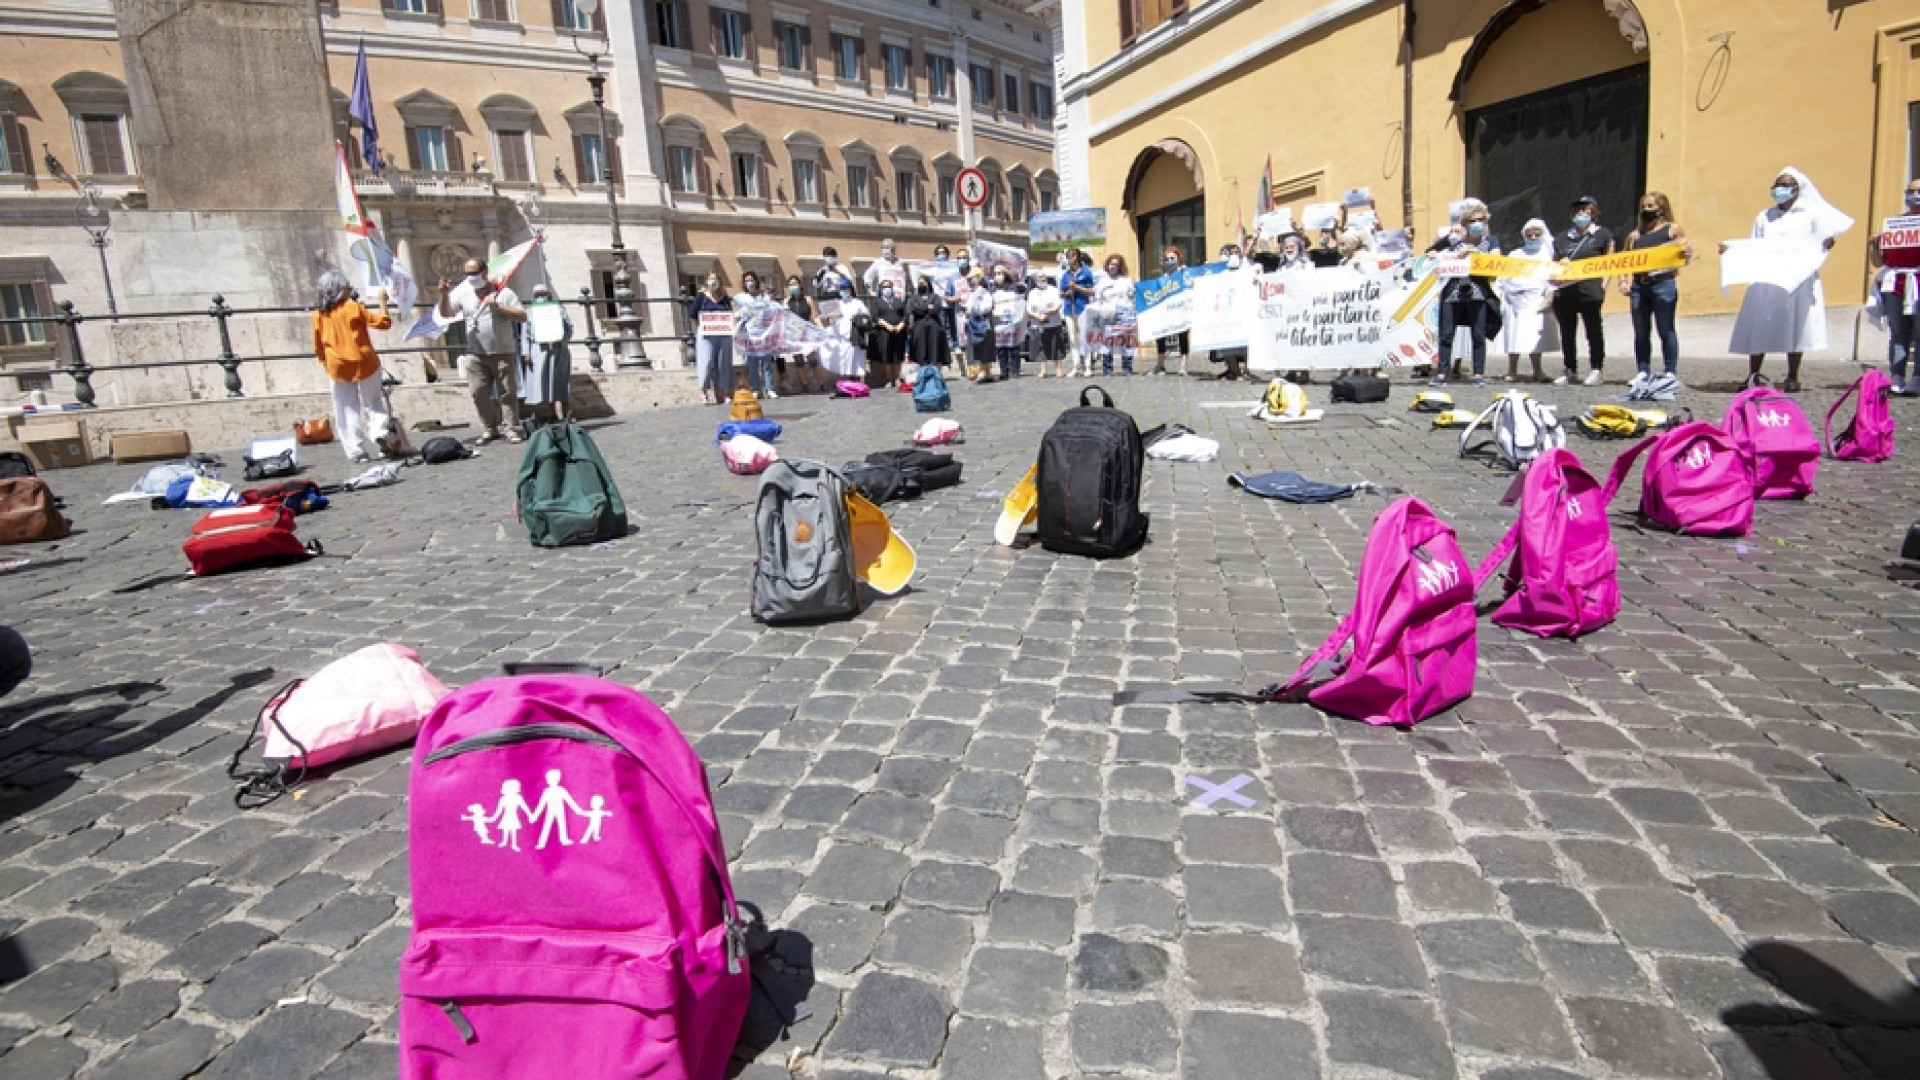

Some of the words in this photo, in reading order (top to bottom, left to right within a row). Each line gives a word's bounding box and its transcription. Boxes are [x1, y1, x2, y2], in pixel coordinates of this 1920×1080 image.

[1882, 229, 1920, 247] ROM
[1582, 253, 1648, 274] GIANELLI
[1333, 280, 1381, 308] parità
[1290, 326, 1334, 347] libertà
